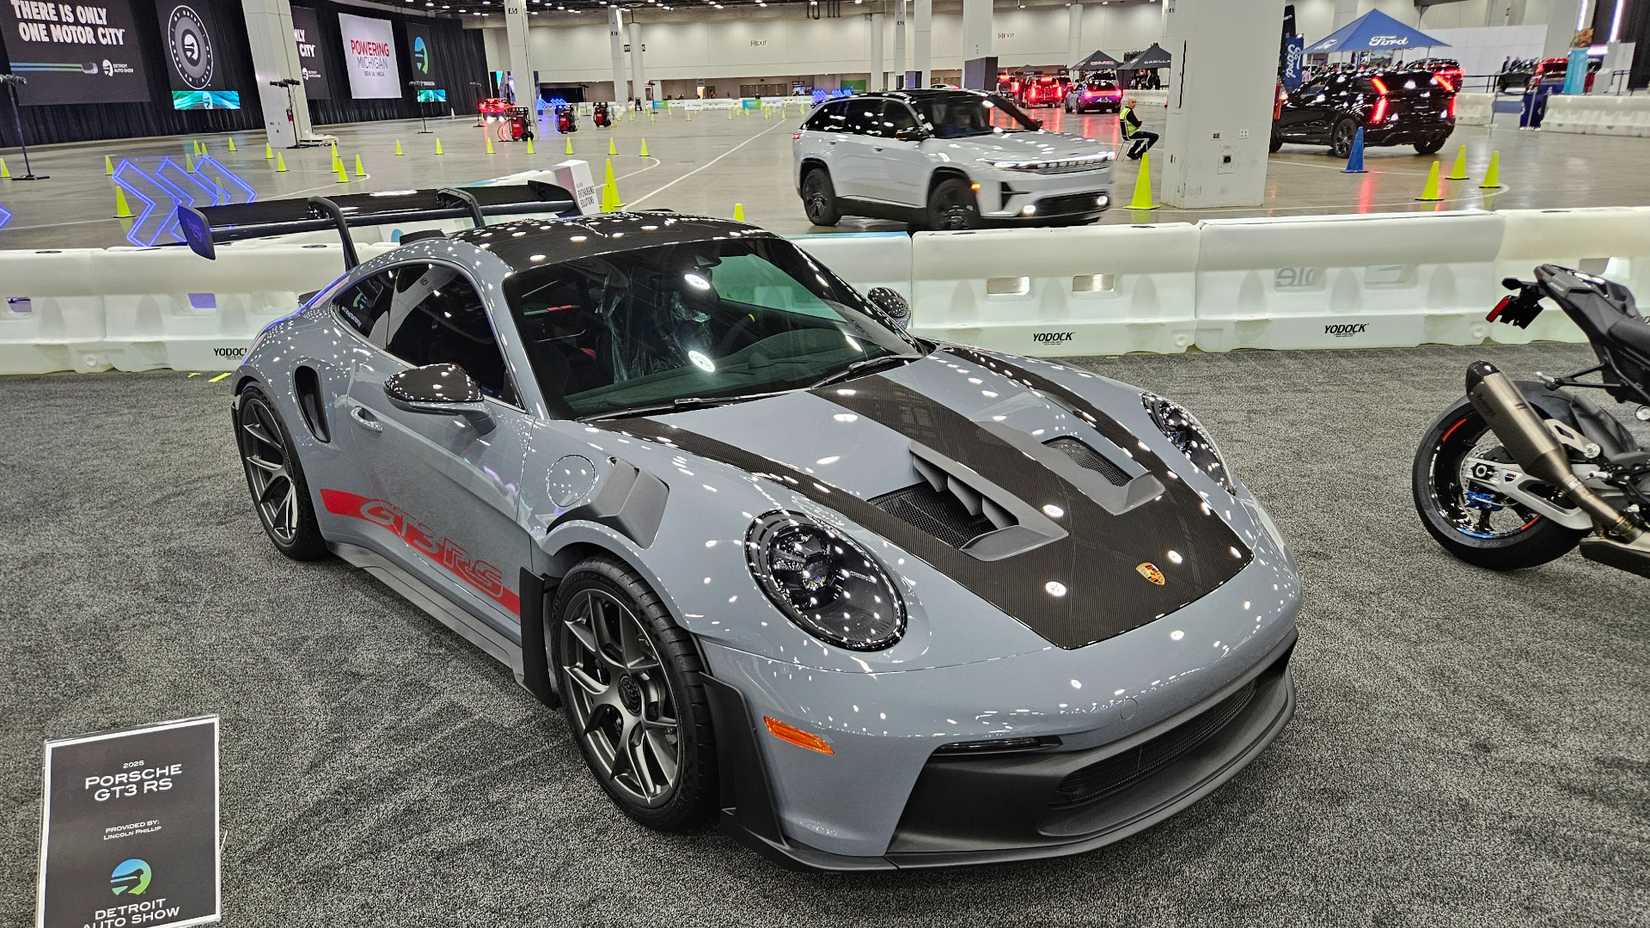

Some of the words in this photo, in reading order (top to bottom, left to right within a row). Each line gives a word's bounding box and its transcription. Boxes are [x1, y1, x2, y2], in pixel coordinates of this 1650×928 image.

[10, 0, 58, 20] THERE
[59, 4, 75, 23] IS
[76, 6, 107, 25] ONLY
[19, 22, 49, 42] ONE
[50, 24, 96, 44] MOTOR
[97, 27, 125, 45] CITY
[1369, 35, 1409, 47] Ford
[299, 44, 316, 57] CITY
[350, 39, 390, 57] POWERING
[1033, 332, 1073, 342] YODOCK
[1324, 323, 1367, 334] YODOCK
[85, 763, 183, 790] PORSCHE
[94, 784, 137, 802] GT3
[143, 778, 173, 794] RS
[103, 830, 134, 841] LINCOLN
[135, 825, 162, 835] PHILLIP
[105, 821, 146, 834] PROVIDED
[83, 915, 126, 928] AUTO
[131, 906, 181, 924] SHOW
[95, 898, 167, 921] DETROIT
